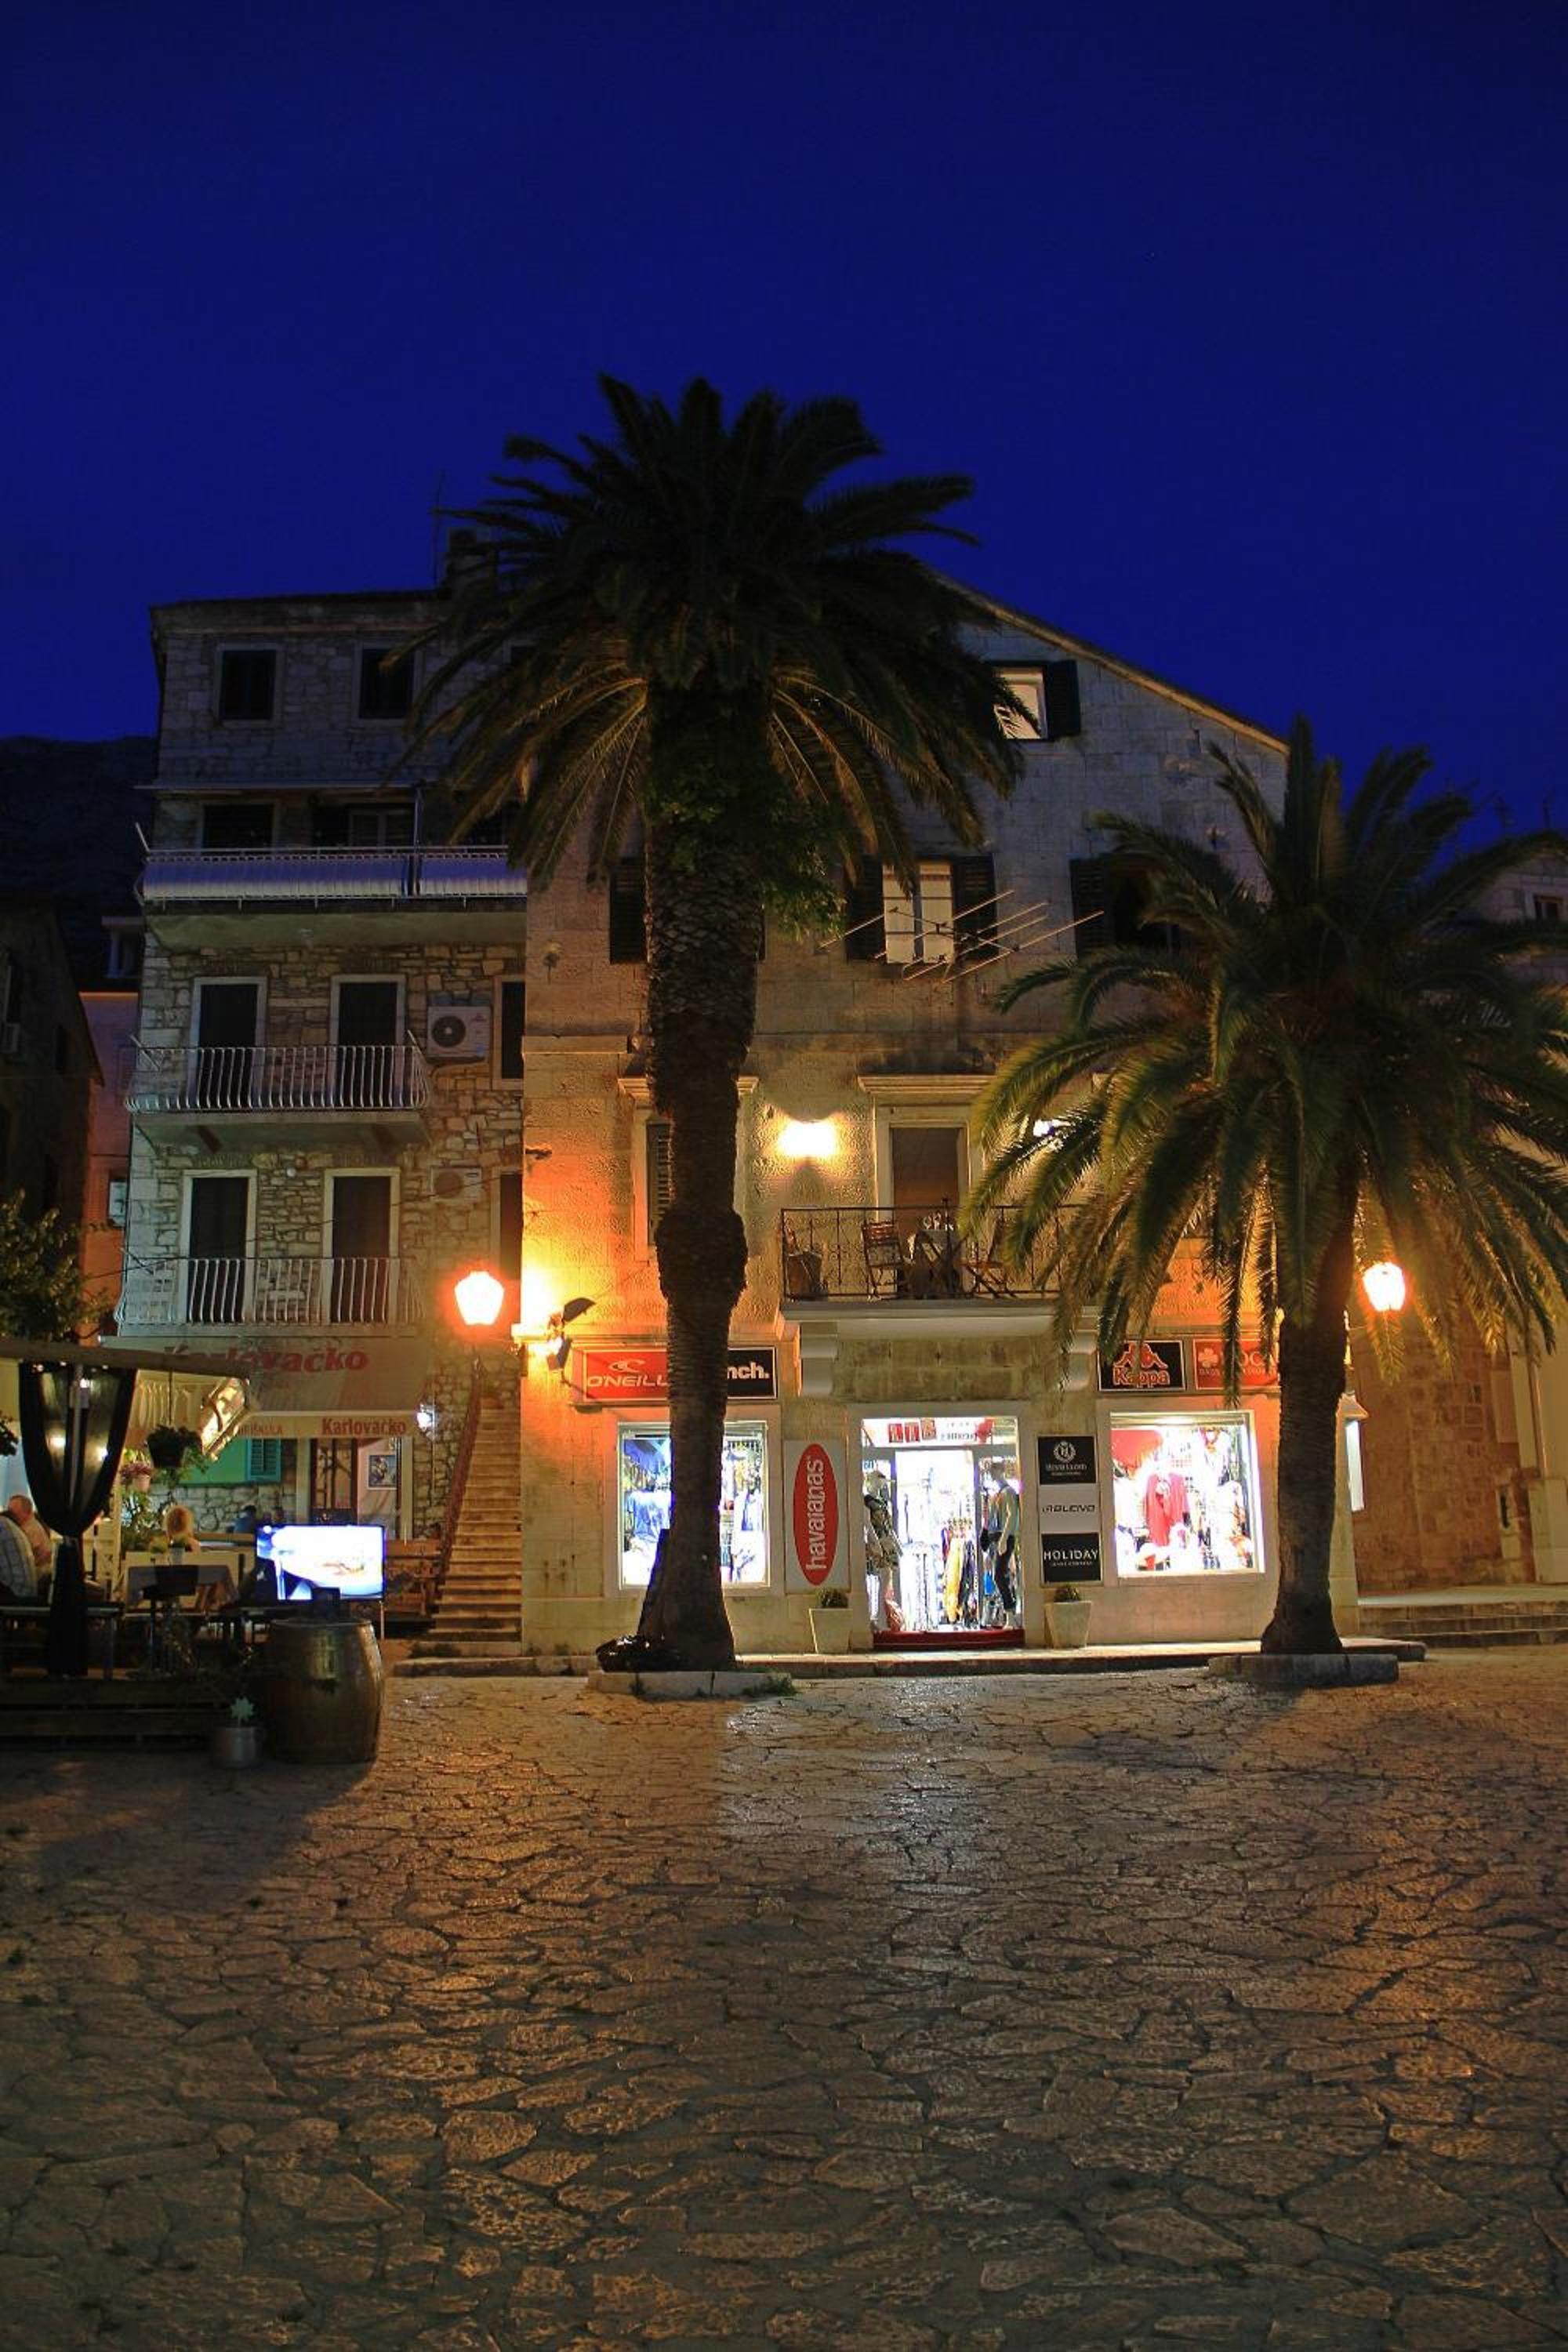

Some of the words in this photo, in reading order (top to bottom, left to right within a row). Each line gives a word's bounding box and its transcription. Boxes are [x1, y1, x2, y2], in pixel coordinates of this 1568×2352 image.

[728, 1361, 770, 1379] nch.
[1113, 1367, 1171, 1388] Kappa
[588, 1374, 670, 1387] O'NEILL
[805, 1457, 827, 1570] havaianas
[1044, 1549, 1098, 1561] HOLIDAY
